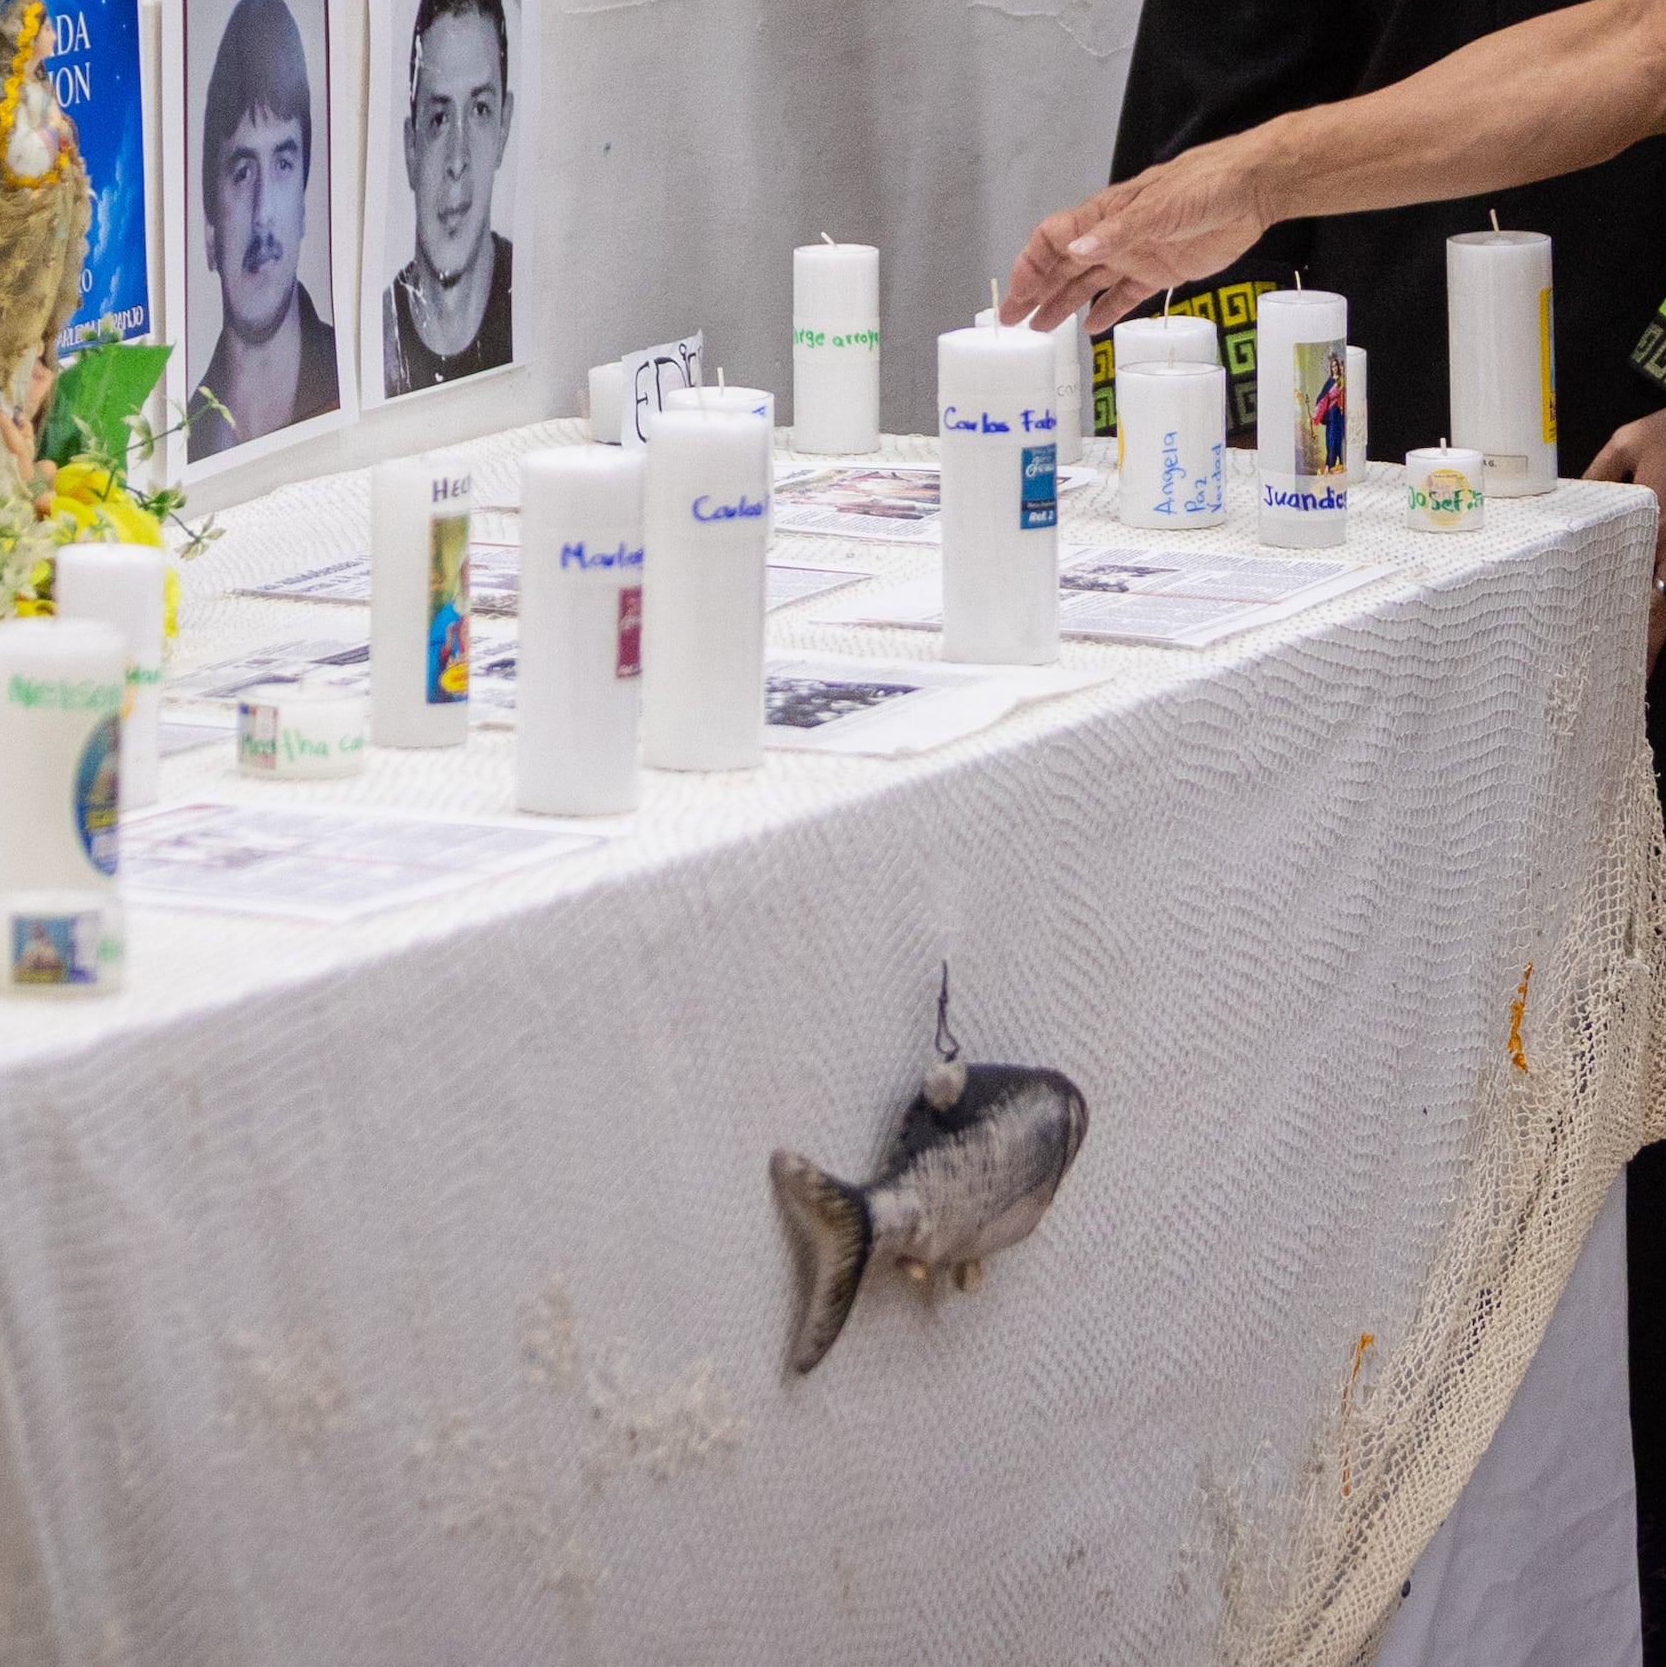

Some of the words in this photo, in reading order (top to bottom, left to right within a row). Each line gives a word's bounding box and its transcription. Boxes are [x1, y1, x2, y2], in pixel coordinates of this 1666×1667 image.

[943, 406, 1011, 434] Carlos
[1020, 408, 1058, 433] Fab
[1153, 430, 1187, 516] Angela
